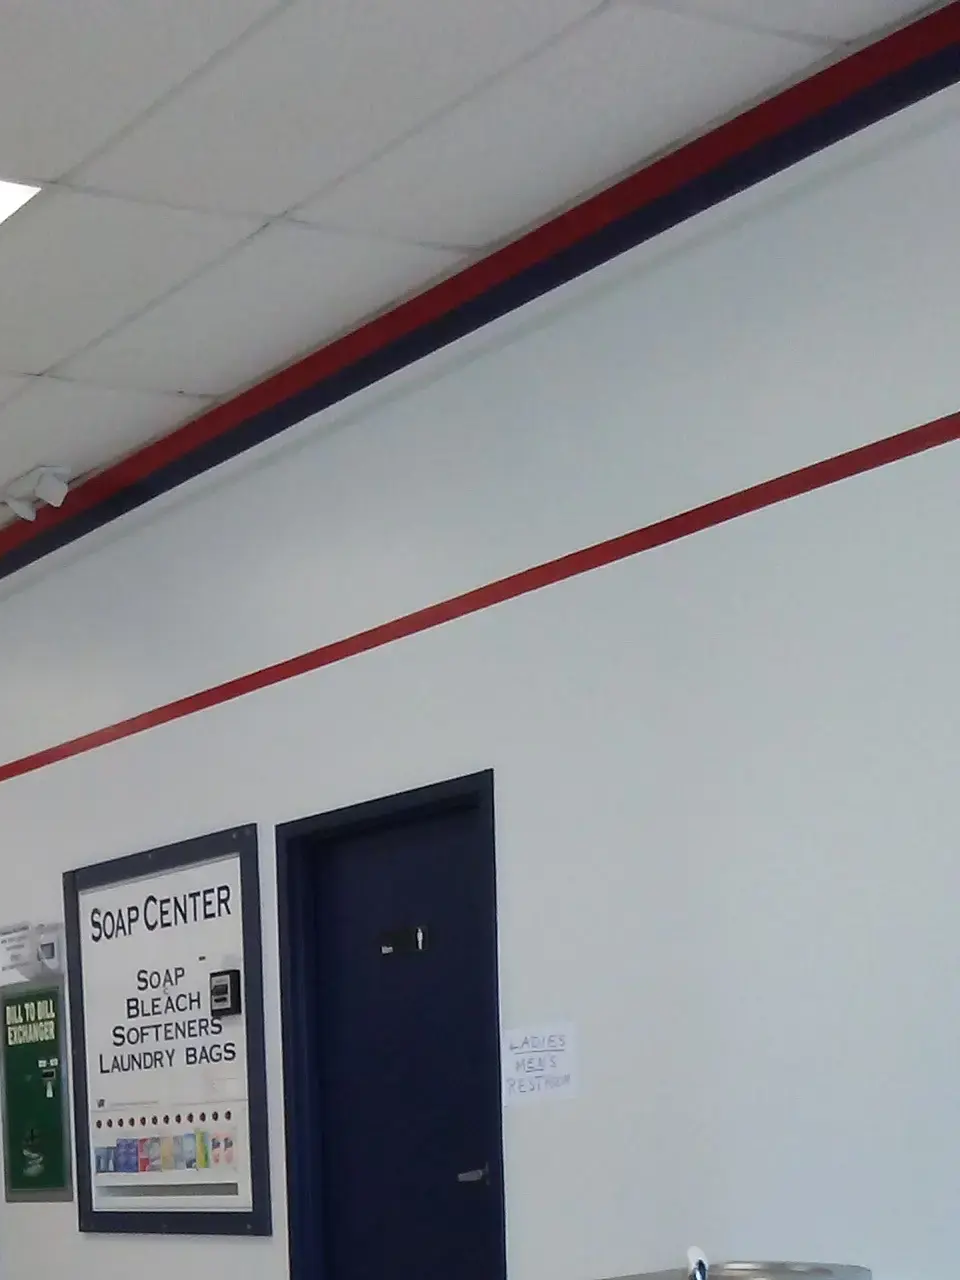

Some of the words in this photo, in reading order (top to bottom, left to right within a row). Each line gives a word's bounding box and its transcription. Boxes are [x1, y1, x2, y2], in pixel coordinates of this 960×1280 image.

[90, 906, 139, 942] SOAP
[144, 885, 232, 931] CENTER
[137, 967, 185, 991] SOAP
[24, 1002, 36, 1022] TO
[127, 992, 201, 1019] BLEACH
[112, 1018, 223, 1047] SOFTENERS
[99, 1049, 175, 1074] LAUNDRY
[186, 1043, 236, 1066] BAGS
